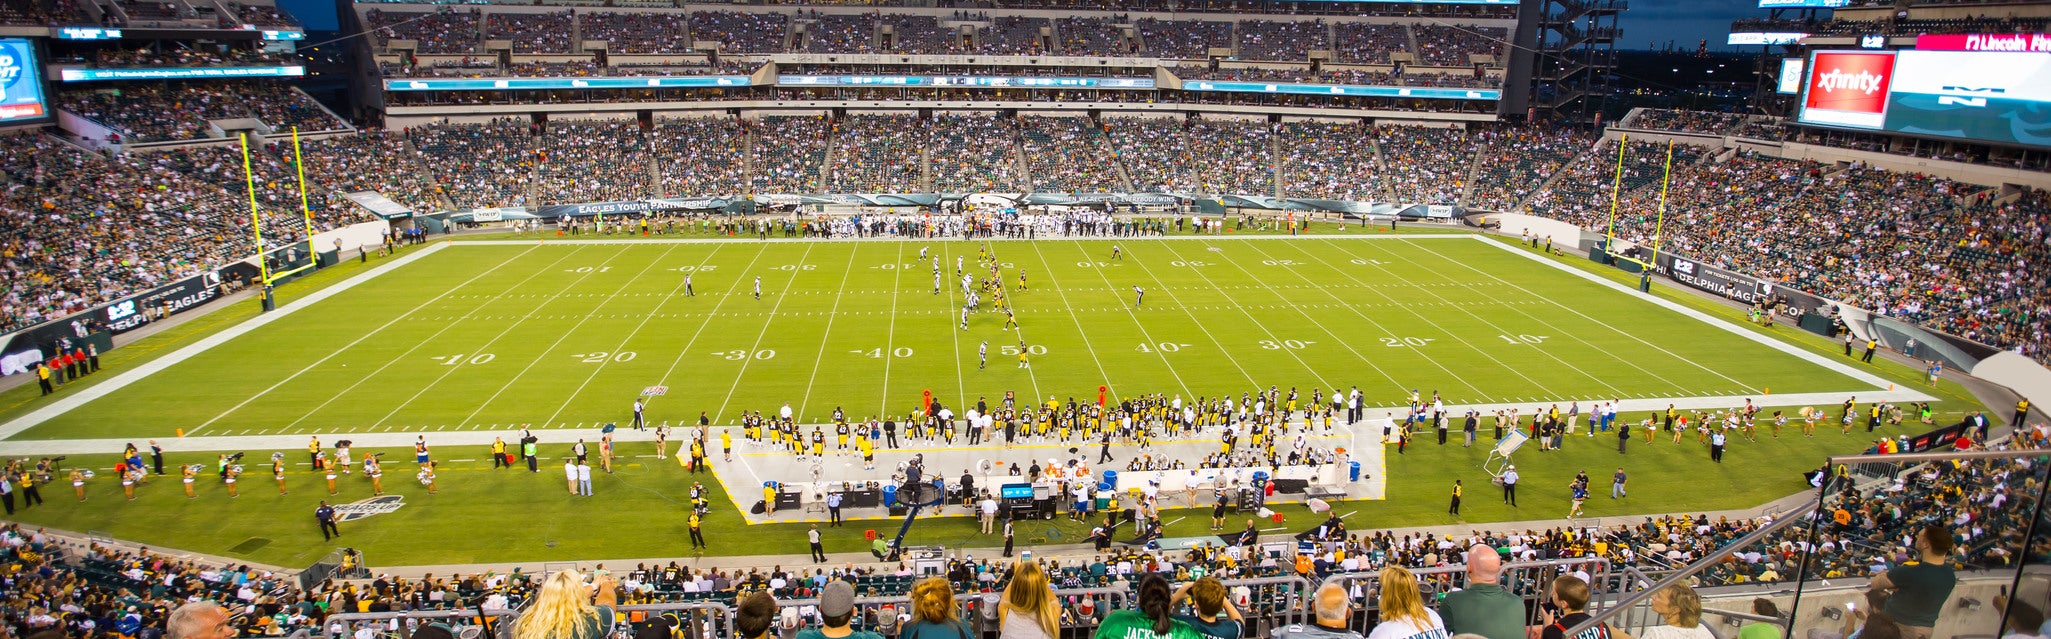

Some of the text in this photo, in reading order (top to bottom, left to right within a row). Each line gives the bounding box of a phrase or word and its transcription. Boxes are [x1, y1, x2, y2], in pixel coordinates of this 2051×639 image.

[1980, 34, 2027, 51] Lincoln
[578, 199, 711, 214] EAGLES YOUTH PARTNERSHIP
[1258, 339, 1306, 350] 30
[1379, 336, 1427, 348] 20
[1498, 334, 1546, 345] 10
[865, 347, 914, 358] 40
[1001, 345, 1048, 356] 50
[1135, 342, 1181, 353] 40
[440, 353, 496, 365] 10
[582, 351, 638, 363] 20
[725, 349, 776, 361] 30
[665, 571, 676, 580] 98
[1106, 566, 1117, 575] 36
